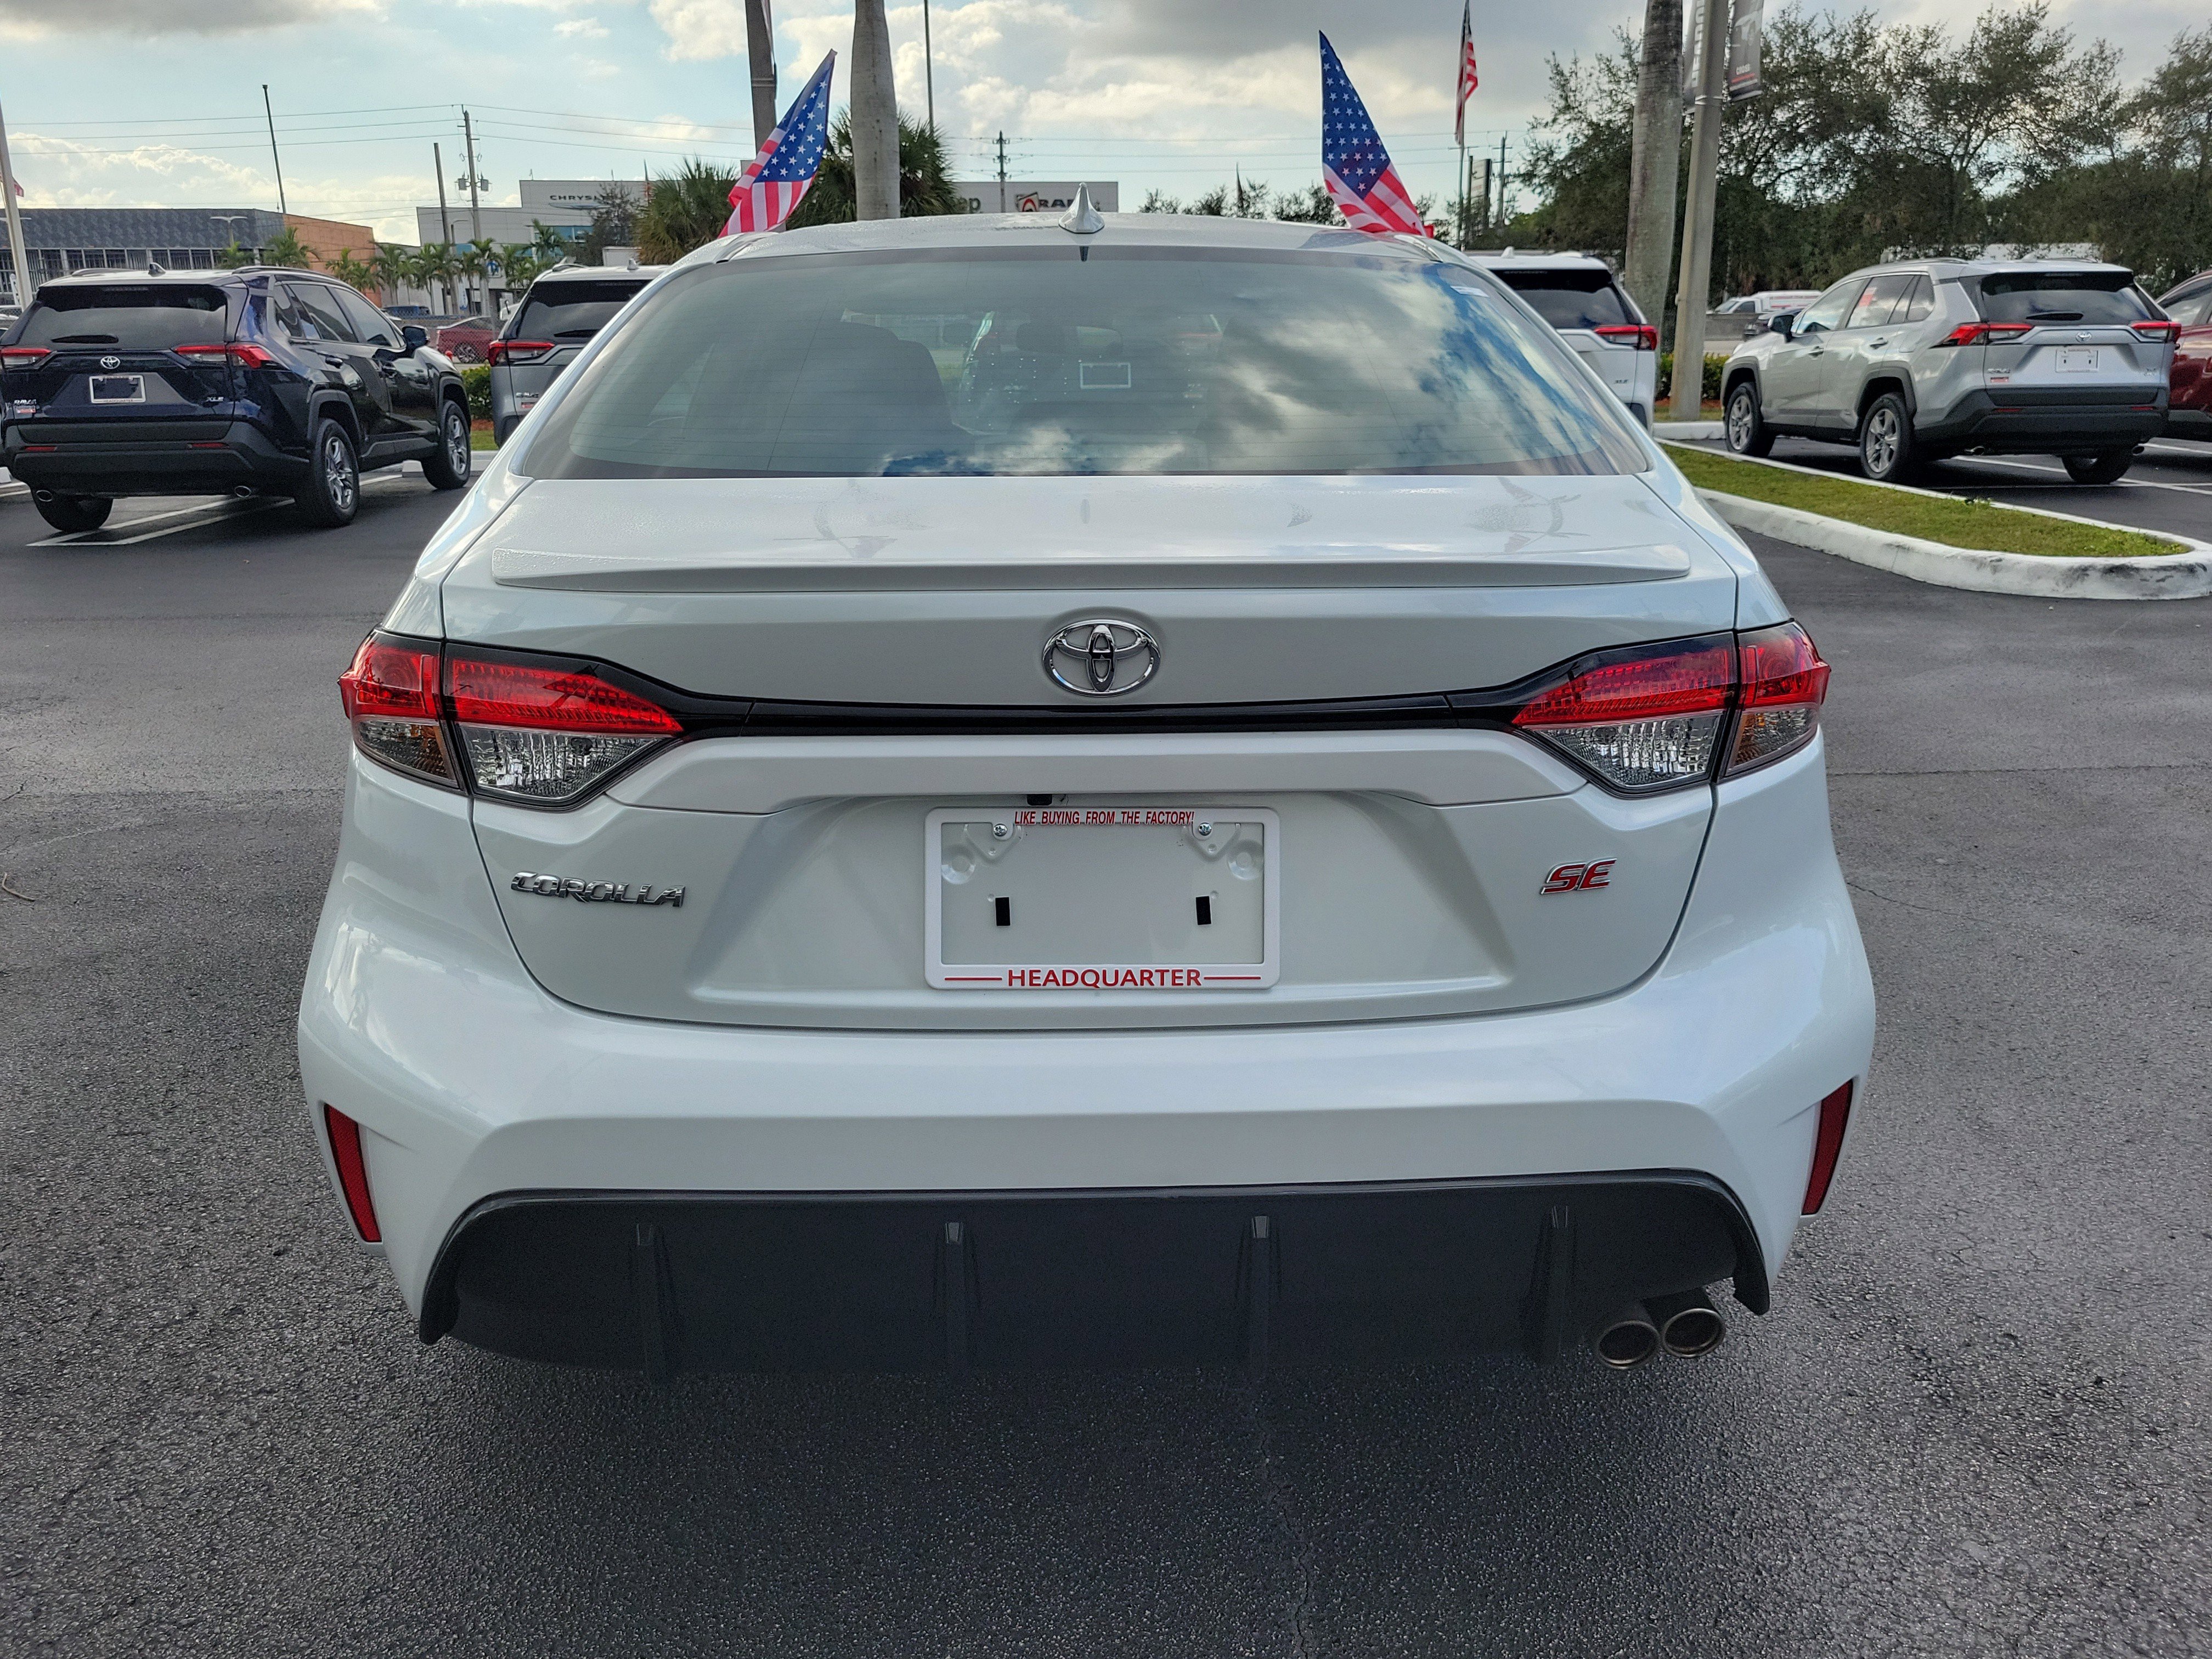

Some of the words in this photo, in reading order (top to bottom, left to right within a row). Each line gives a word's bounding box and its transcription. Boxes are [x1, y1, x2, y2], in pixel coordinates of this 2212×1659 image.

[1015, 811, 1036, 824] LIKE
[1042, 811, 1080, 824] BUYING
[1086, 811, 1115, 824] FROM
[1121, 811, 1140, 824] THE
[1146, 811, 1194, 824] FACTORY!
[511, 871, 685, 907] COROLLA
[1540, 856, 1617, 895] SE
[1008, 969, 1201, 989] HEADQUARTER
